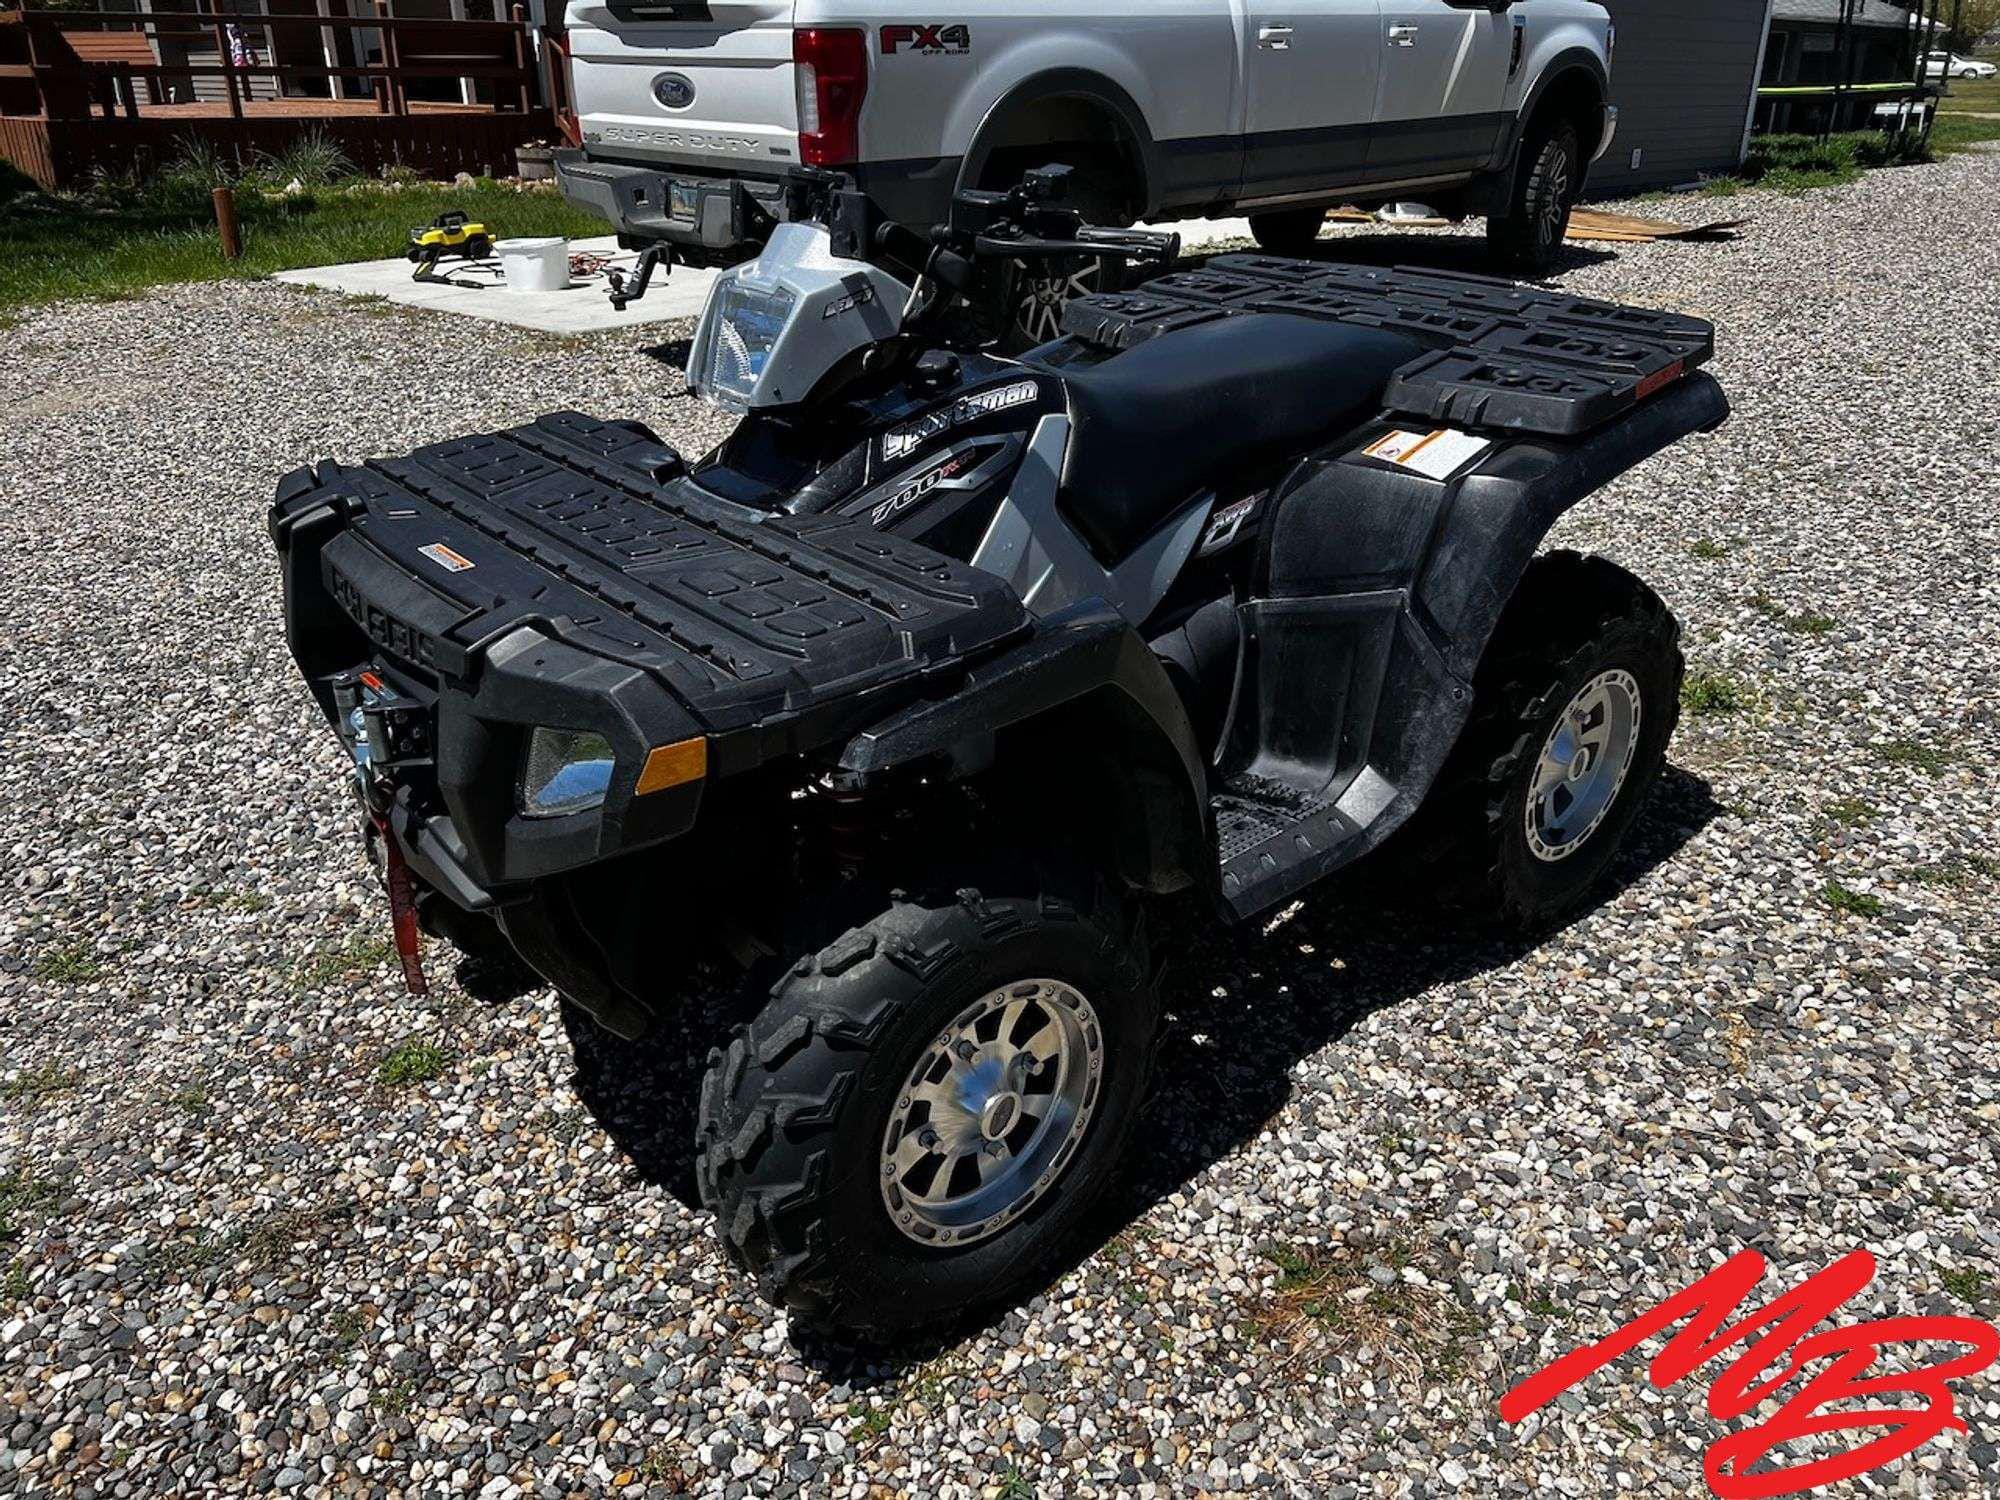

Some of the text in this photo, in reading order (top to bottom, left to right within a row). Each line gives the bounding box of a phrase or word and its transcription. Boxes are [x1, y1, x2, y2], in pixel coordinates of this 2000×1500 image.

[880, 24, 970, 54] FX4
[605, 127, 684, 147] SUPER
[689, 134, 760, 153] DUTY
[882, 379, 1039, 461] Sportsman
[871, 466, 943, 527] 700
